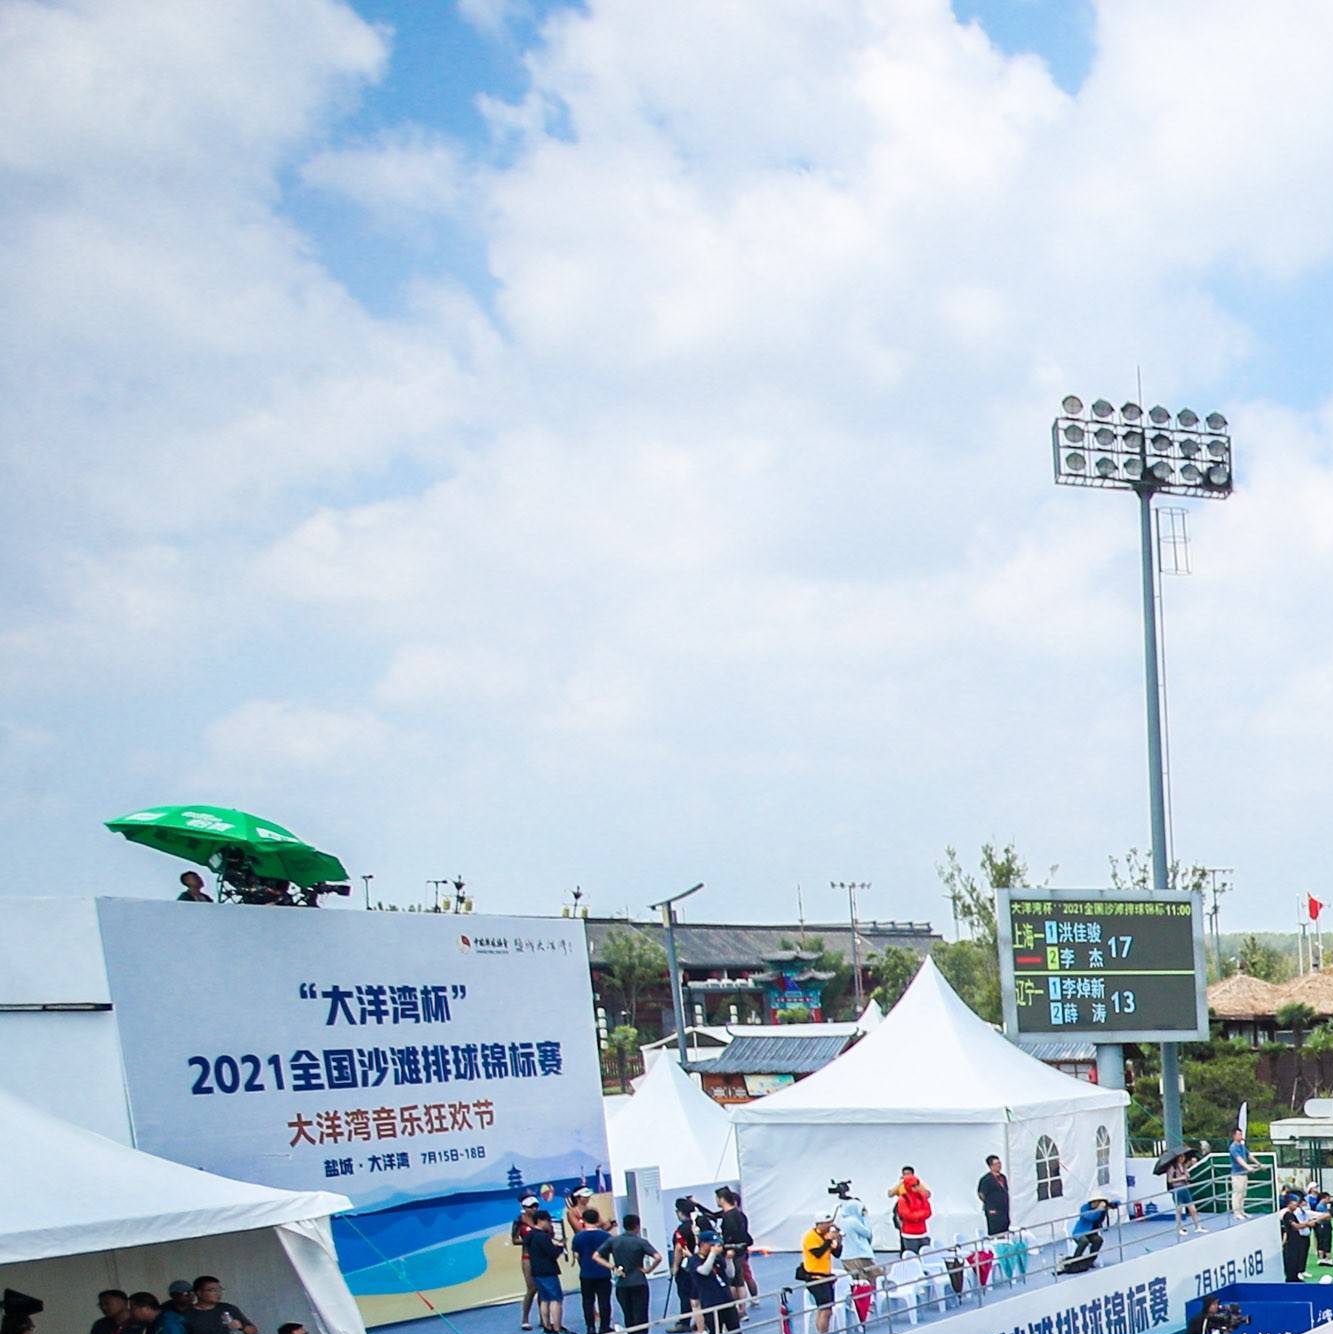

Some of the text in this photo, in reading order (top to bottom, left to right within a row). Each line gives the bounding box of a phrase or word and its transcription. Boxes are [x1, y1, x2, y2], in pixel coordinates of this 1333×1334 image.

[1107, 936, 1132, 958] 17
[1111, 991, 1136, 1013] 13
[188, 1041, 563, 1095] 2021全国沙滩排球锦标赛
[287, 1099, 495, 1147] 大洋湾音乐狂欢节
